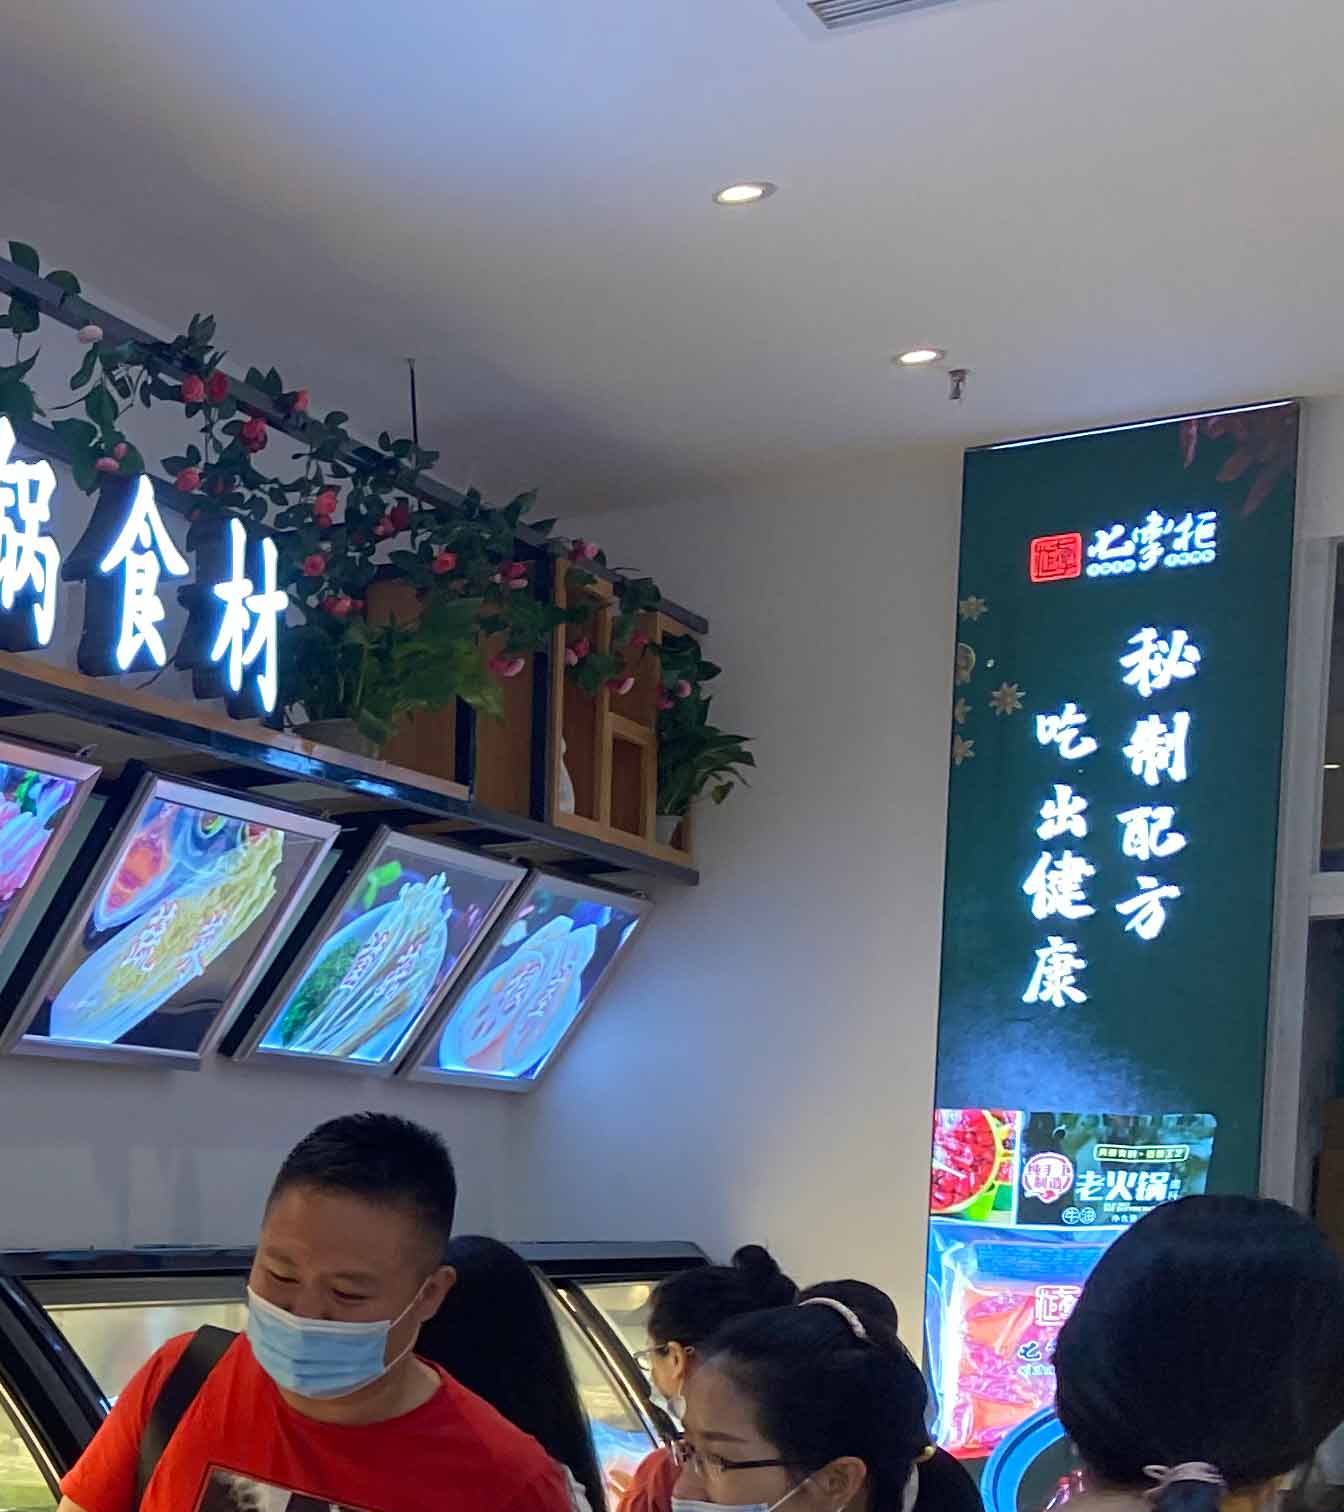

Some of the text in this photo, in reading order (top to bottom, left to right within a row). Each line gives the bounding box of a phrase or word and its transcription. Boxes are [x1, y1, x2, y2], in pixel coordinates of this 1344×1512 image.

[1087, 510, 1217, 571] 七掌柜
[1022, 702, 1100, 1008] 吃出健康
[1115, 625, 1201, 940] 秘制配方
[121, 900, 227, 977] 蔬菜
